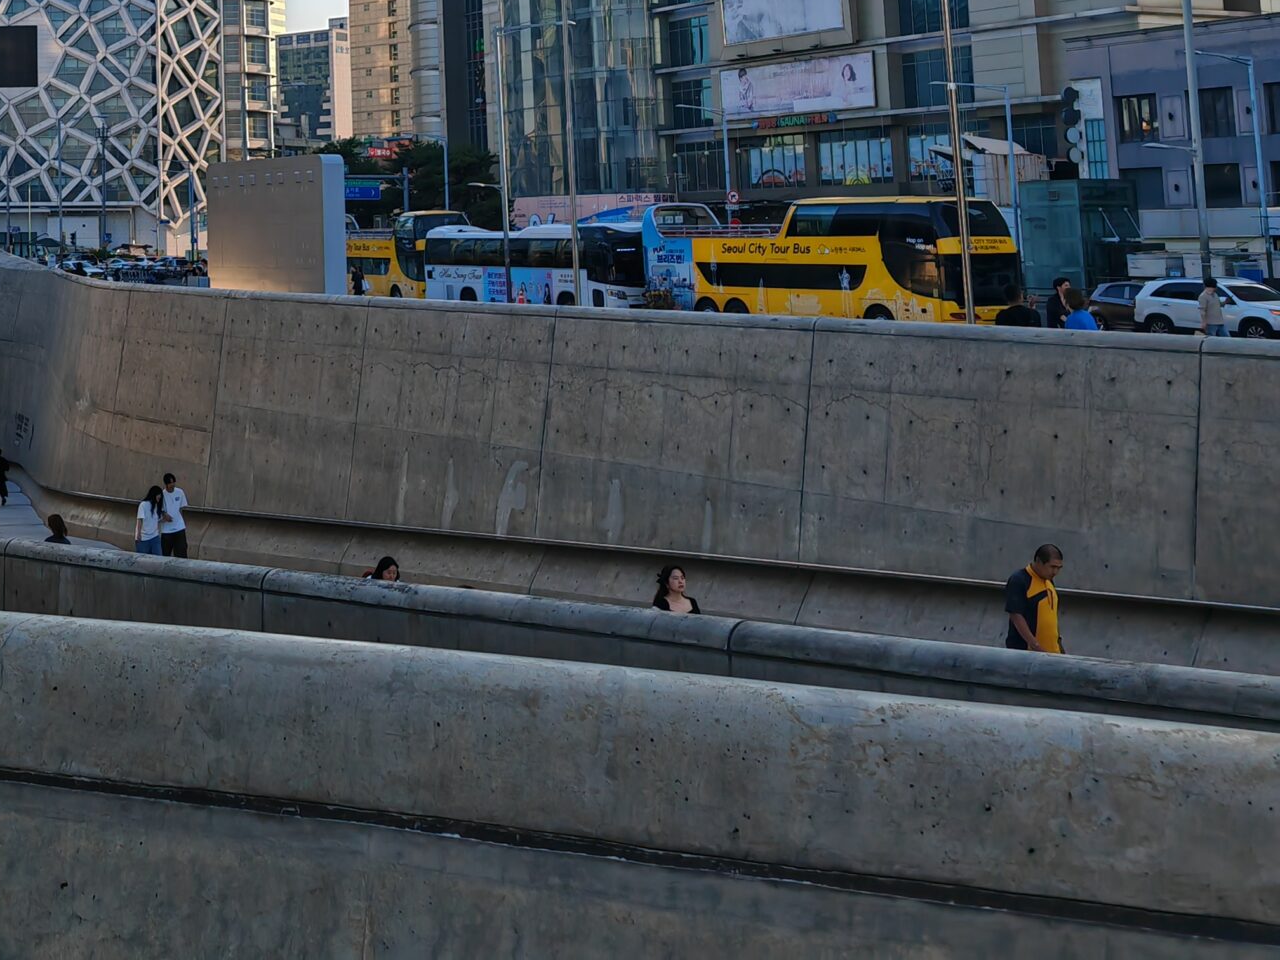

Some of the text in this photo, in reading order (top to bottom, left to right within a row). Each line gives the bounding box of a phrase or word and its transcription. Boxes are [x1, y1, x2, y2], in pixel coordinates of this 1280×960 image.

[722, 242, 811, 256] Seoul City Tour Bus
